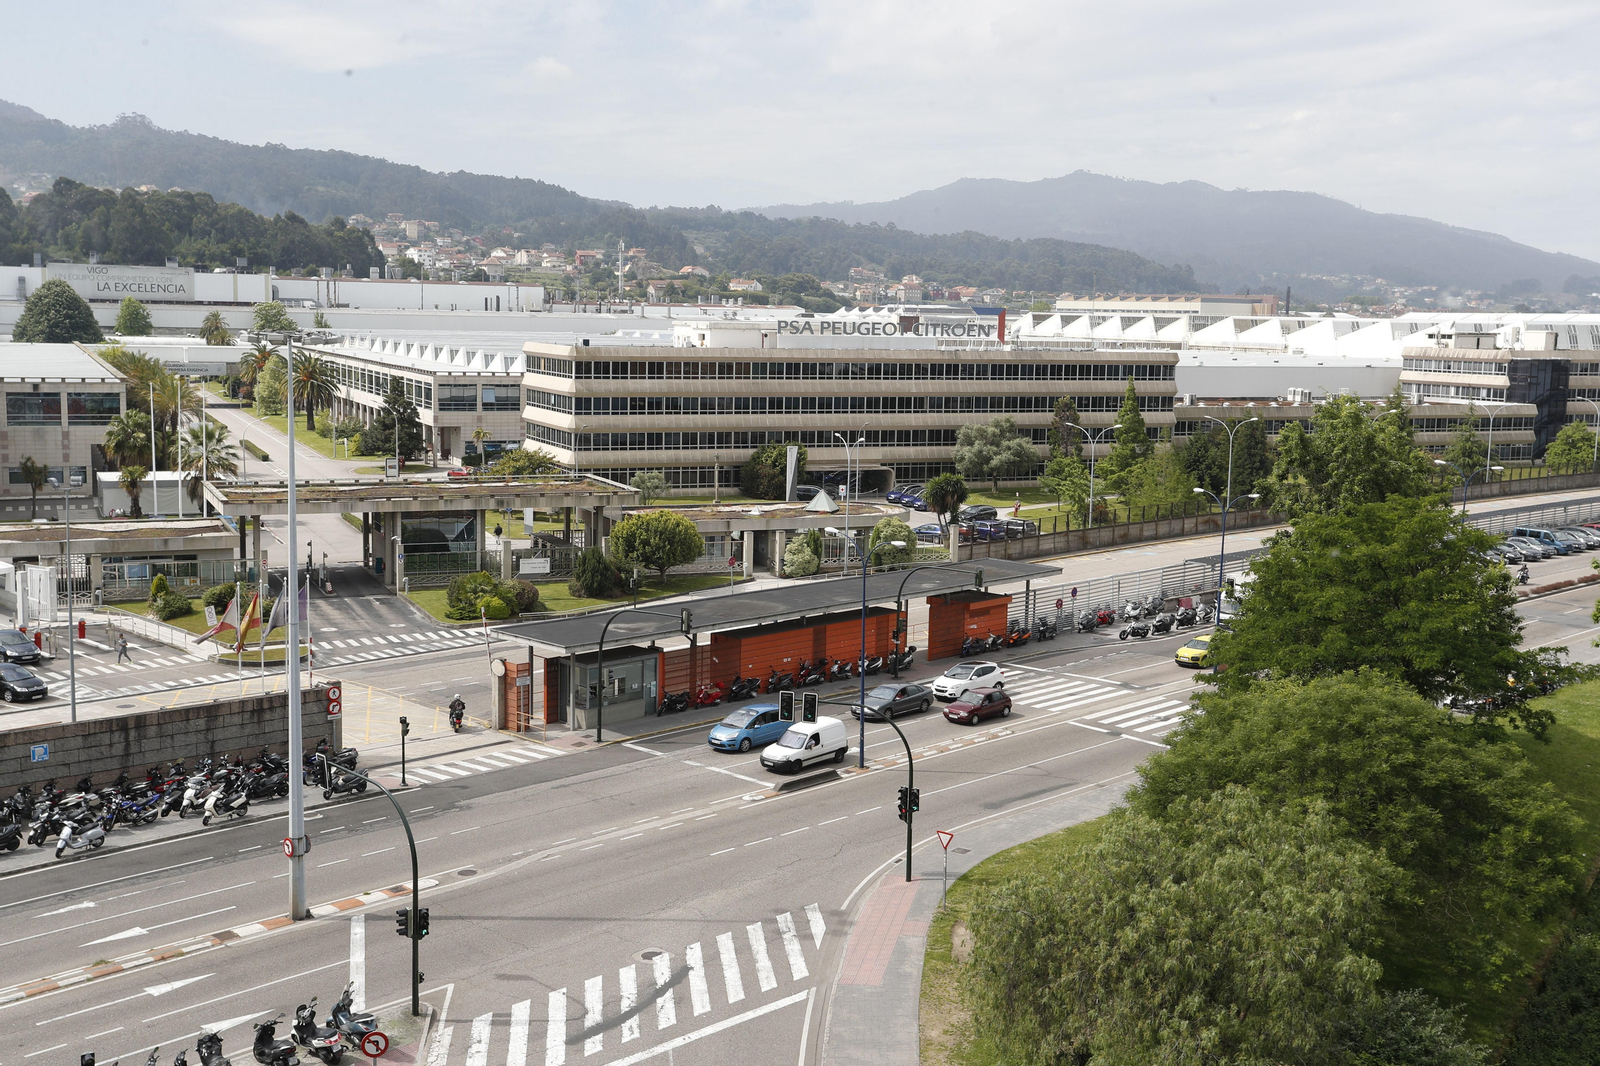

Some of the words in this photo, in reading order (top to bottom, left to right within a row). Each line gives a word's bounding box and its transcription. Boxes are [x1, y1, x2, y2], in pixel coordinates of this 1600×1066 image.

[86, 266, 109, 274] VIGO
[67, 273, 95, 281] EQUIPO
[96, 275, 154, 283] COMPROMETIDO
[155, 276, 173, 284] CON
[96, 282, 112, 292] LA
[114, 282, 187, 294] EXCELENCIA
[777, 320, 814, 335] PSA
[819, 321, 909, 336] PEUGEOT
[912, 320, 992, 337] CITROËN
